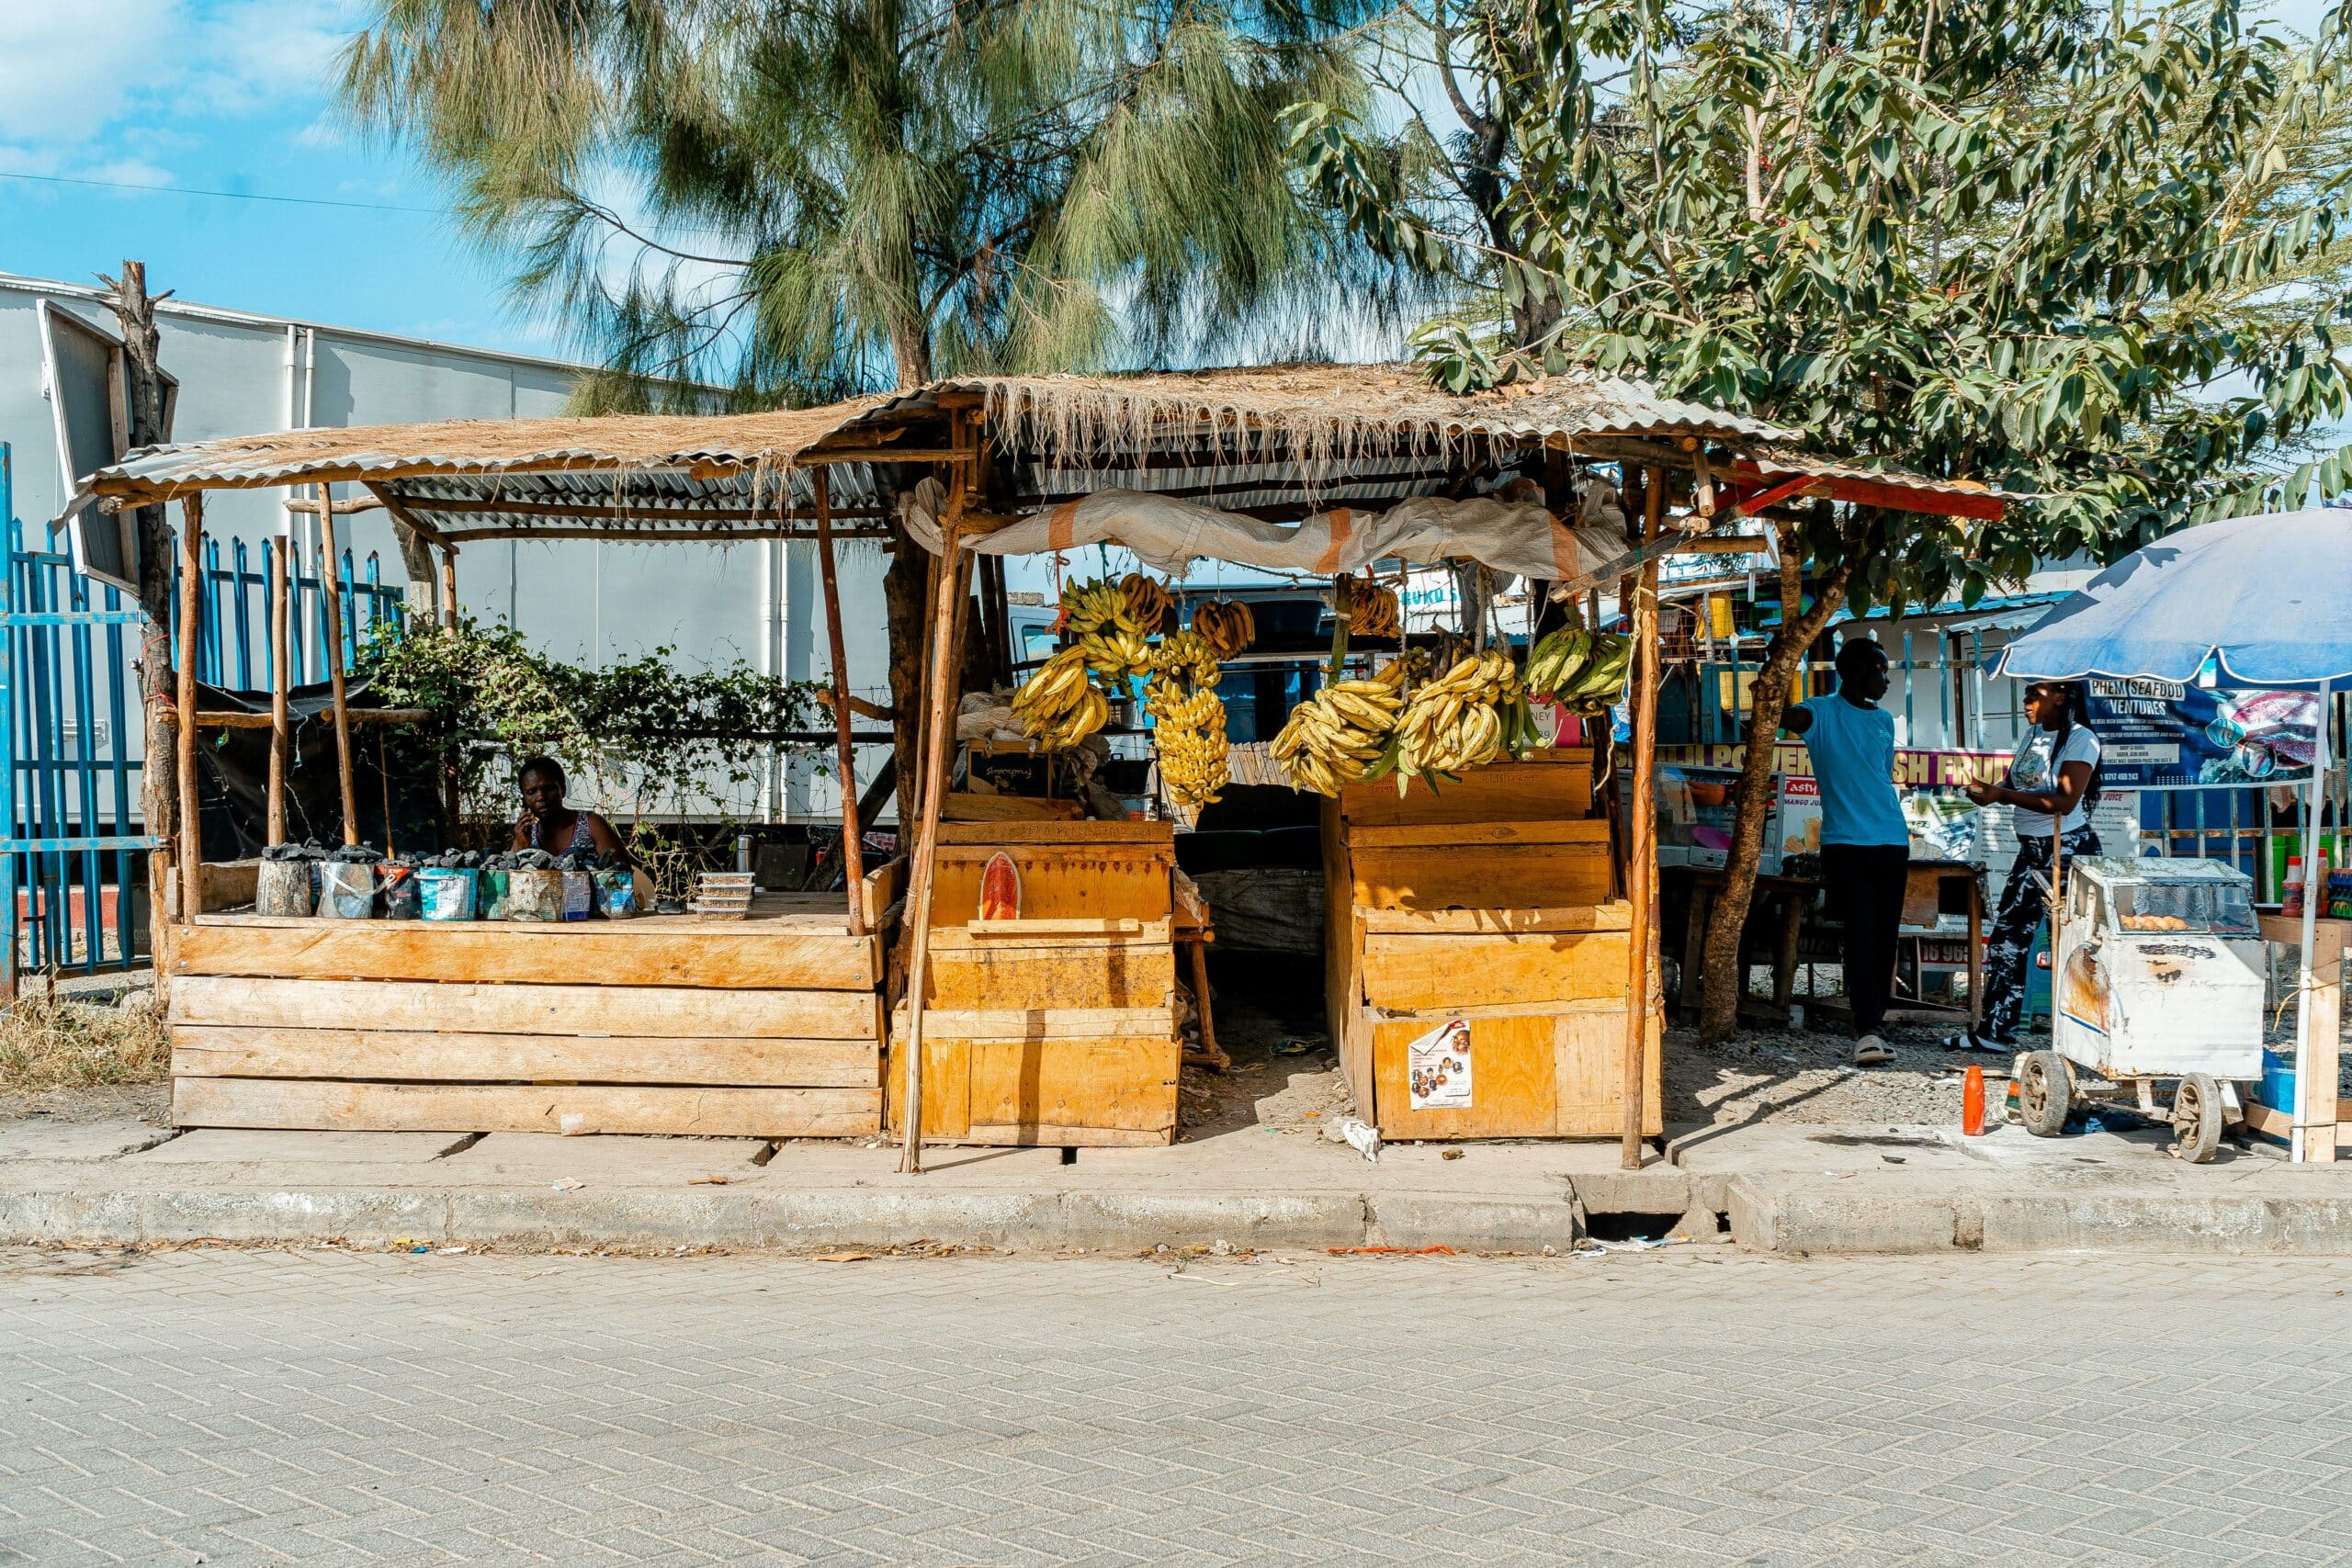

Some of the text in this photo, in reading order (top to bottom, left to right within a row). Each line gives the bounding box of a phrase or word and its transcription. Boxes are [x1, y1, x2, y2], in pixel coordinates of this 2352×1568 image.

[1401, 589, 1443, 605] KUKU
[2093, 681, 2182, 697] PHEM SEAFOOD
[2109, 699, 2166, 715] VENTURES
